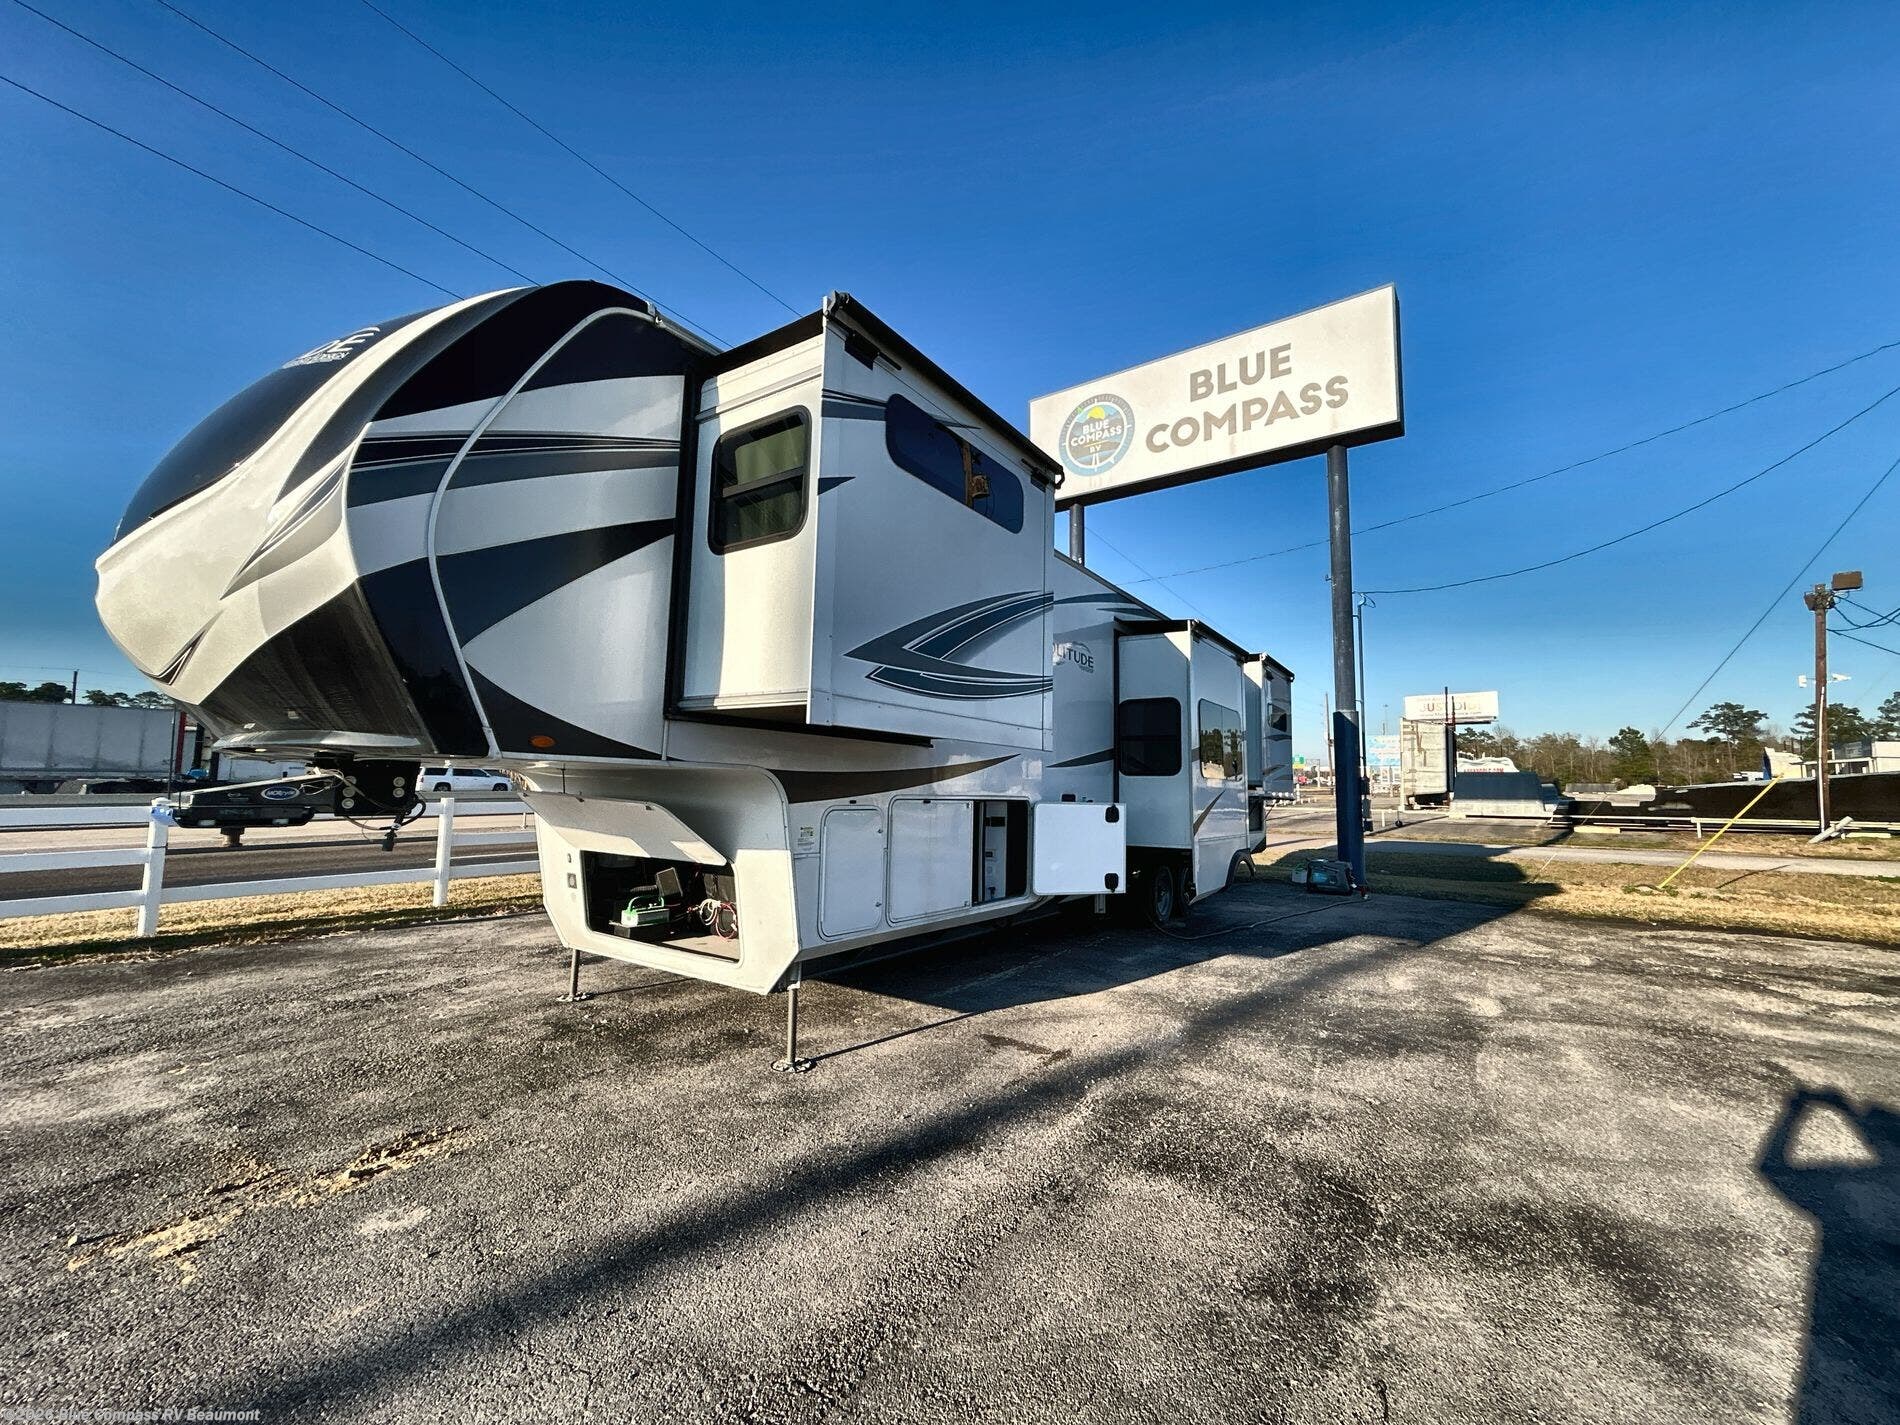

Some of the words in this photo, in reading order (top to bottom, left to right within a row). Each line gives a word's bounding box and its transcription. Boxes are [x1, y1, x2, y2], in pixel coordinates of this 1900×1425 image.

[1189, 343, 1292, 402] BLUE
[1082, 419, 1110, 435] BLUE
[1145, 375, 1349, 453] COMPASS
[1070, 425, 1122, 447] COMPASS
